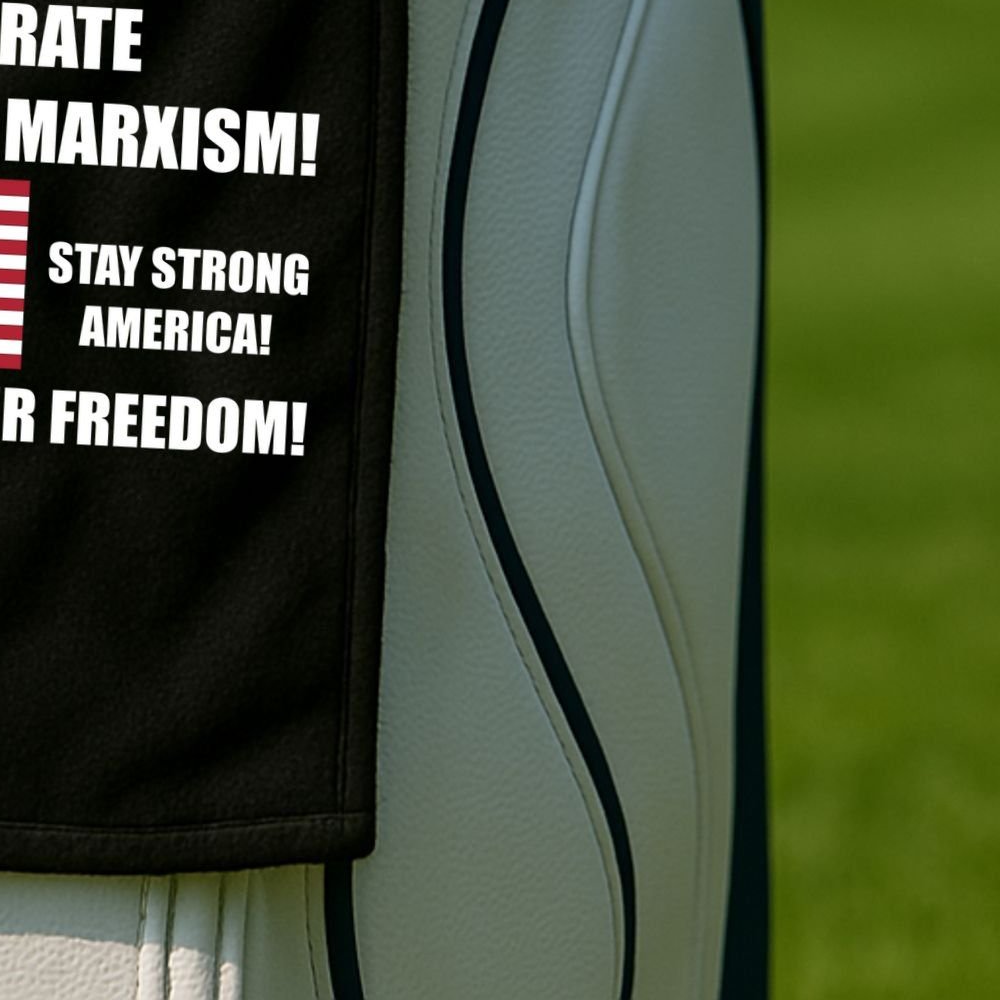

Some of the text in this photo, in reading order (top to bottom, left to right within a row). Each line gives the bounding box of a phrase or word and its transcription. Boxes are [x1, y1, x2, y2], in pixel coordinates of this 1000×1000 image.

[4, 98, 320, 177] MARXISM!
[48, 241, 310, 296] STAY STRONG
[78, 305, 273, 356] AMERICA!
[50, 389, 308, 456] FREEDOM!
